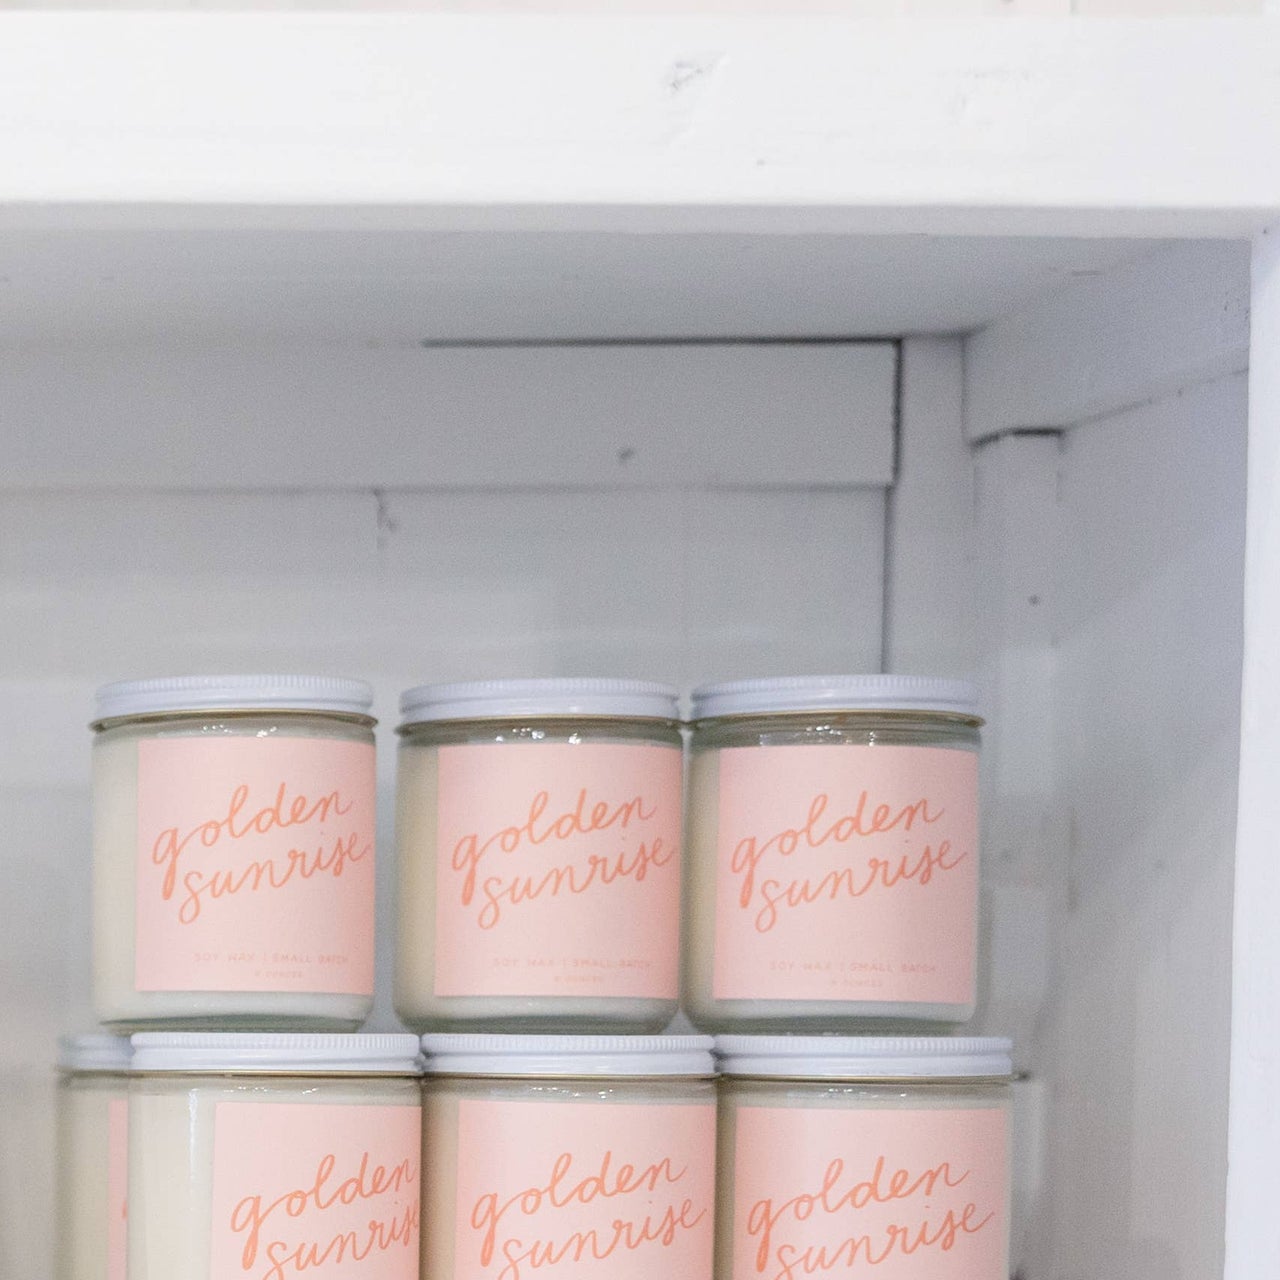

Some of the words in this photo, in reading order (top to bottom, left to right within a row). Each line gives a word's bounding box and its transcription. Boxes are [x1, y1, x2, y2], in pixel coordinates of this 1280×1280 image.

[151, 782, 352, 901] golden
[179, 832, 371, 925] sunrise
[451, 788, 657, 906] golden
[477, 838, 675, 930] sunrise
[730, 790, 944, 909] golden
[754, 840, 968, 933] sunrise
[230, 1151, 414, 1271] golden
[470, 1150, 686, 1267] golden
[747, 1155, 970, 1273] golden
